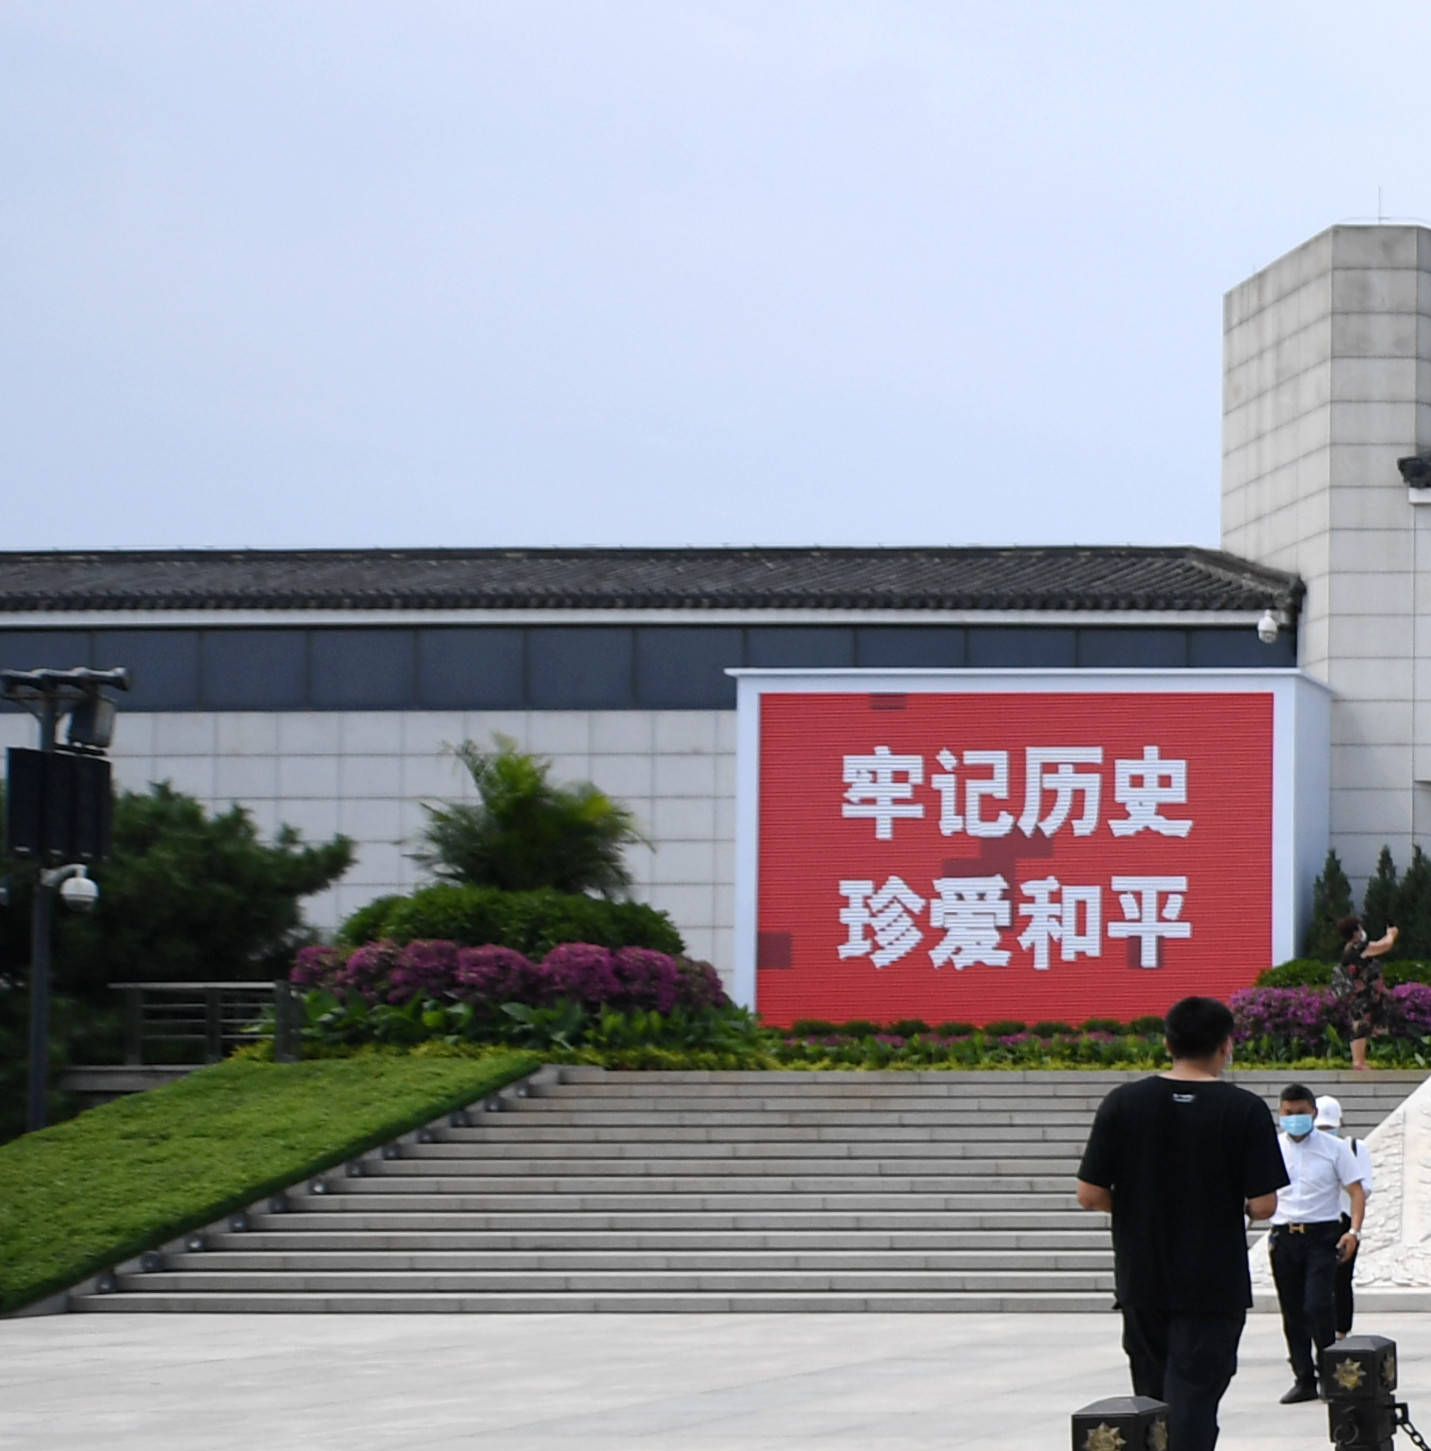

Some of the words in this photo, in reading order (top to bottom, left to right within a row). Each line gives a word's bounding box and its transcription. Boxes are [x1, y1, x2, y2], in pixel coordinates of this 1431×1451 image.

[841, 746, 1194, 840] 牢记历史
[837, 875, 1193, 970] 珍爱和平
